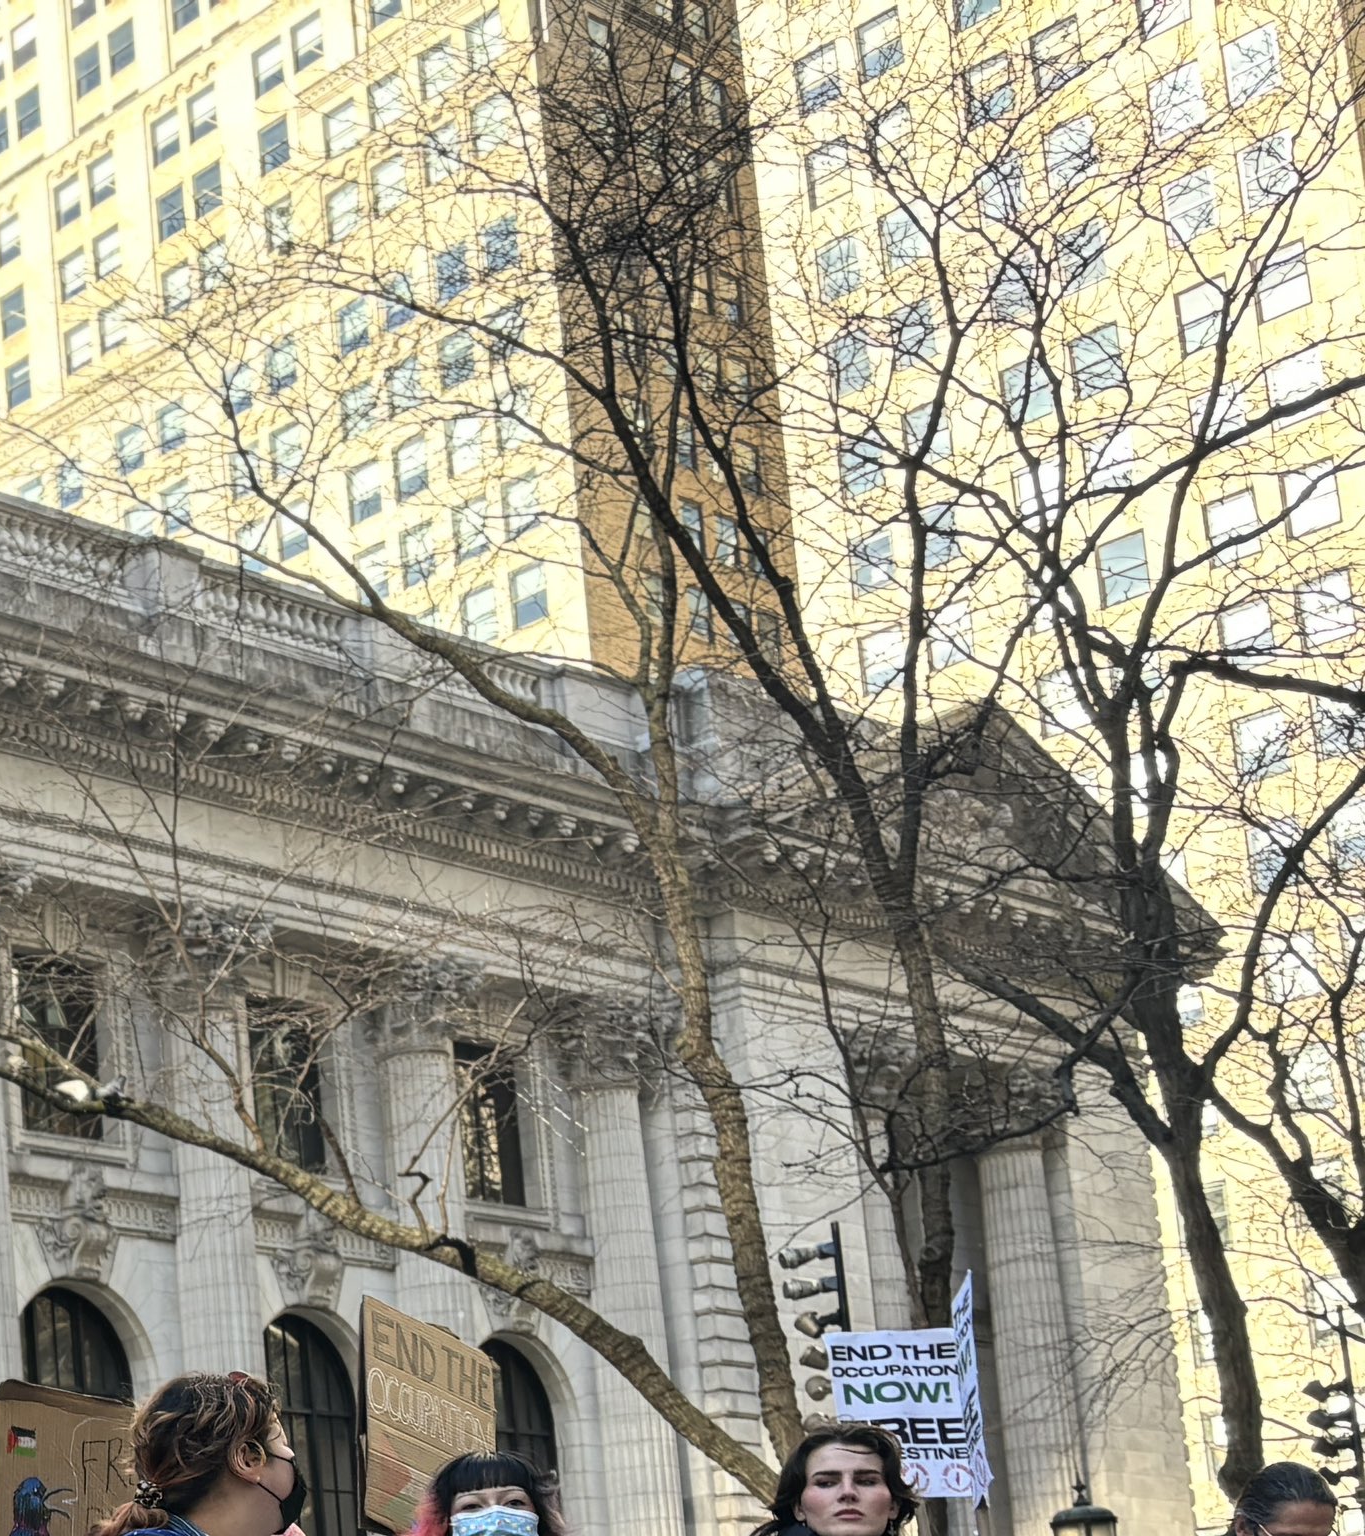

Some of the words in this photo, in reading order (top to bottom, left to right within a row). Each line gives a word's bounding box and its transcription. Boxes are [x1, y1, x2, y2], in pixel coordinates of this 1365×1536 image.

[372, 1311, 436, 1383] END
[441, 1345, 492, 1412] THE
[831, 1345, 892, 1361] END
[896, 1343, 956, 1360] THE
[832, 1364, 958, 1377] OCCUPATION
[843, 1381, 953, 1405] NOW!
